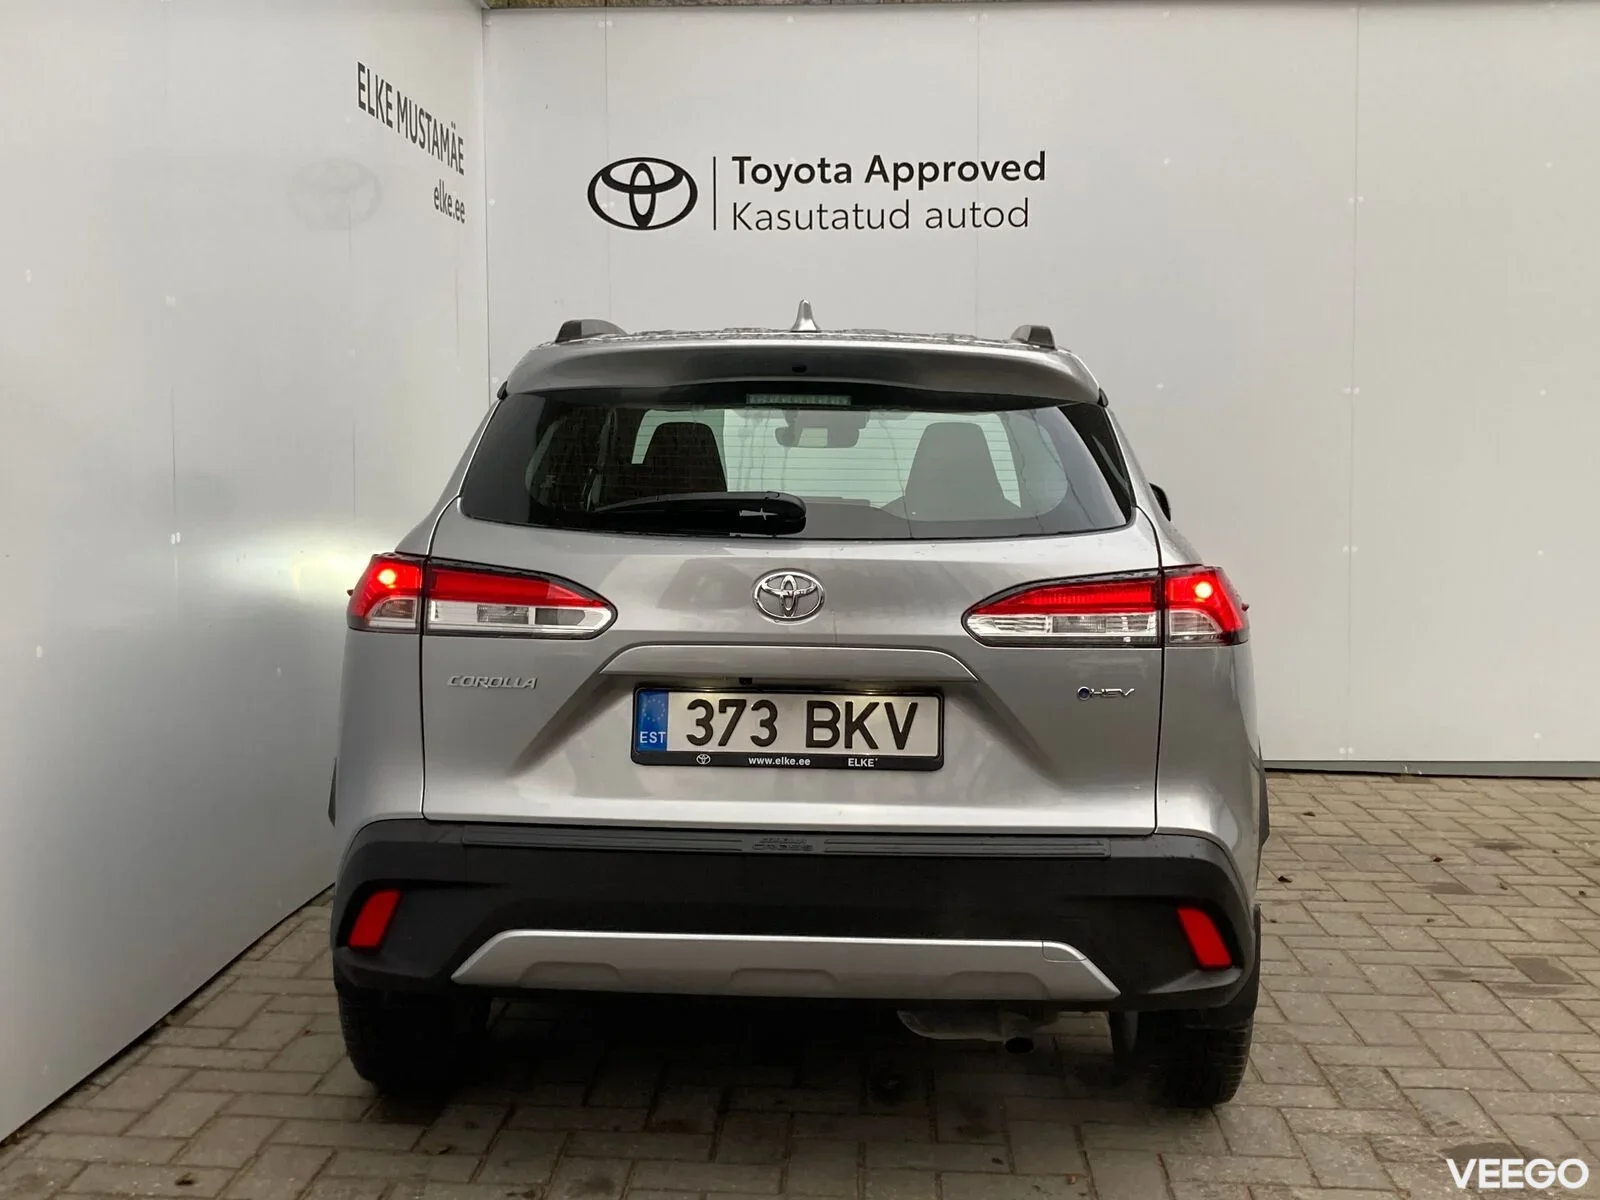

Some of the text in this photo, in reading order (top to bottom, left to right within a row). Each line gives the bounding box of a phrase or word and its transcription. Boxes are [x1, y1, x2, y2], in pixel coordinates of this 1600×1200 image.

[357, 61, 465, 176] ELKE MUSTAMÄE
[732, 151, 1047, 193] Toyota Approved
[433, 178, 466, 224] elke.ee
[732, 197, 1029, 231] Kasutatud autod
[447, 675, 538, 689] COROLLA
[639, 731, 667, 744] EST
[686, 698, 918, 750] 373 BKV
[748, 756, 811, 767] www.elke.ee
[847, 757, 876, 768] ELKE
